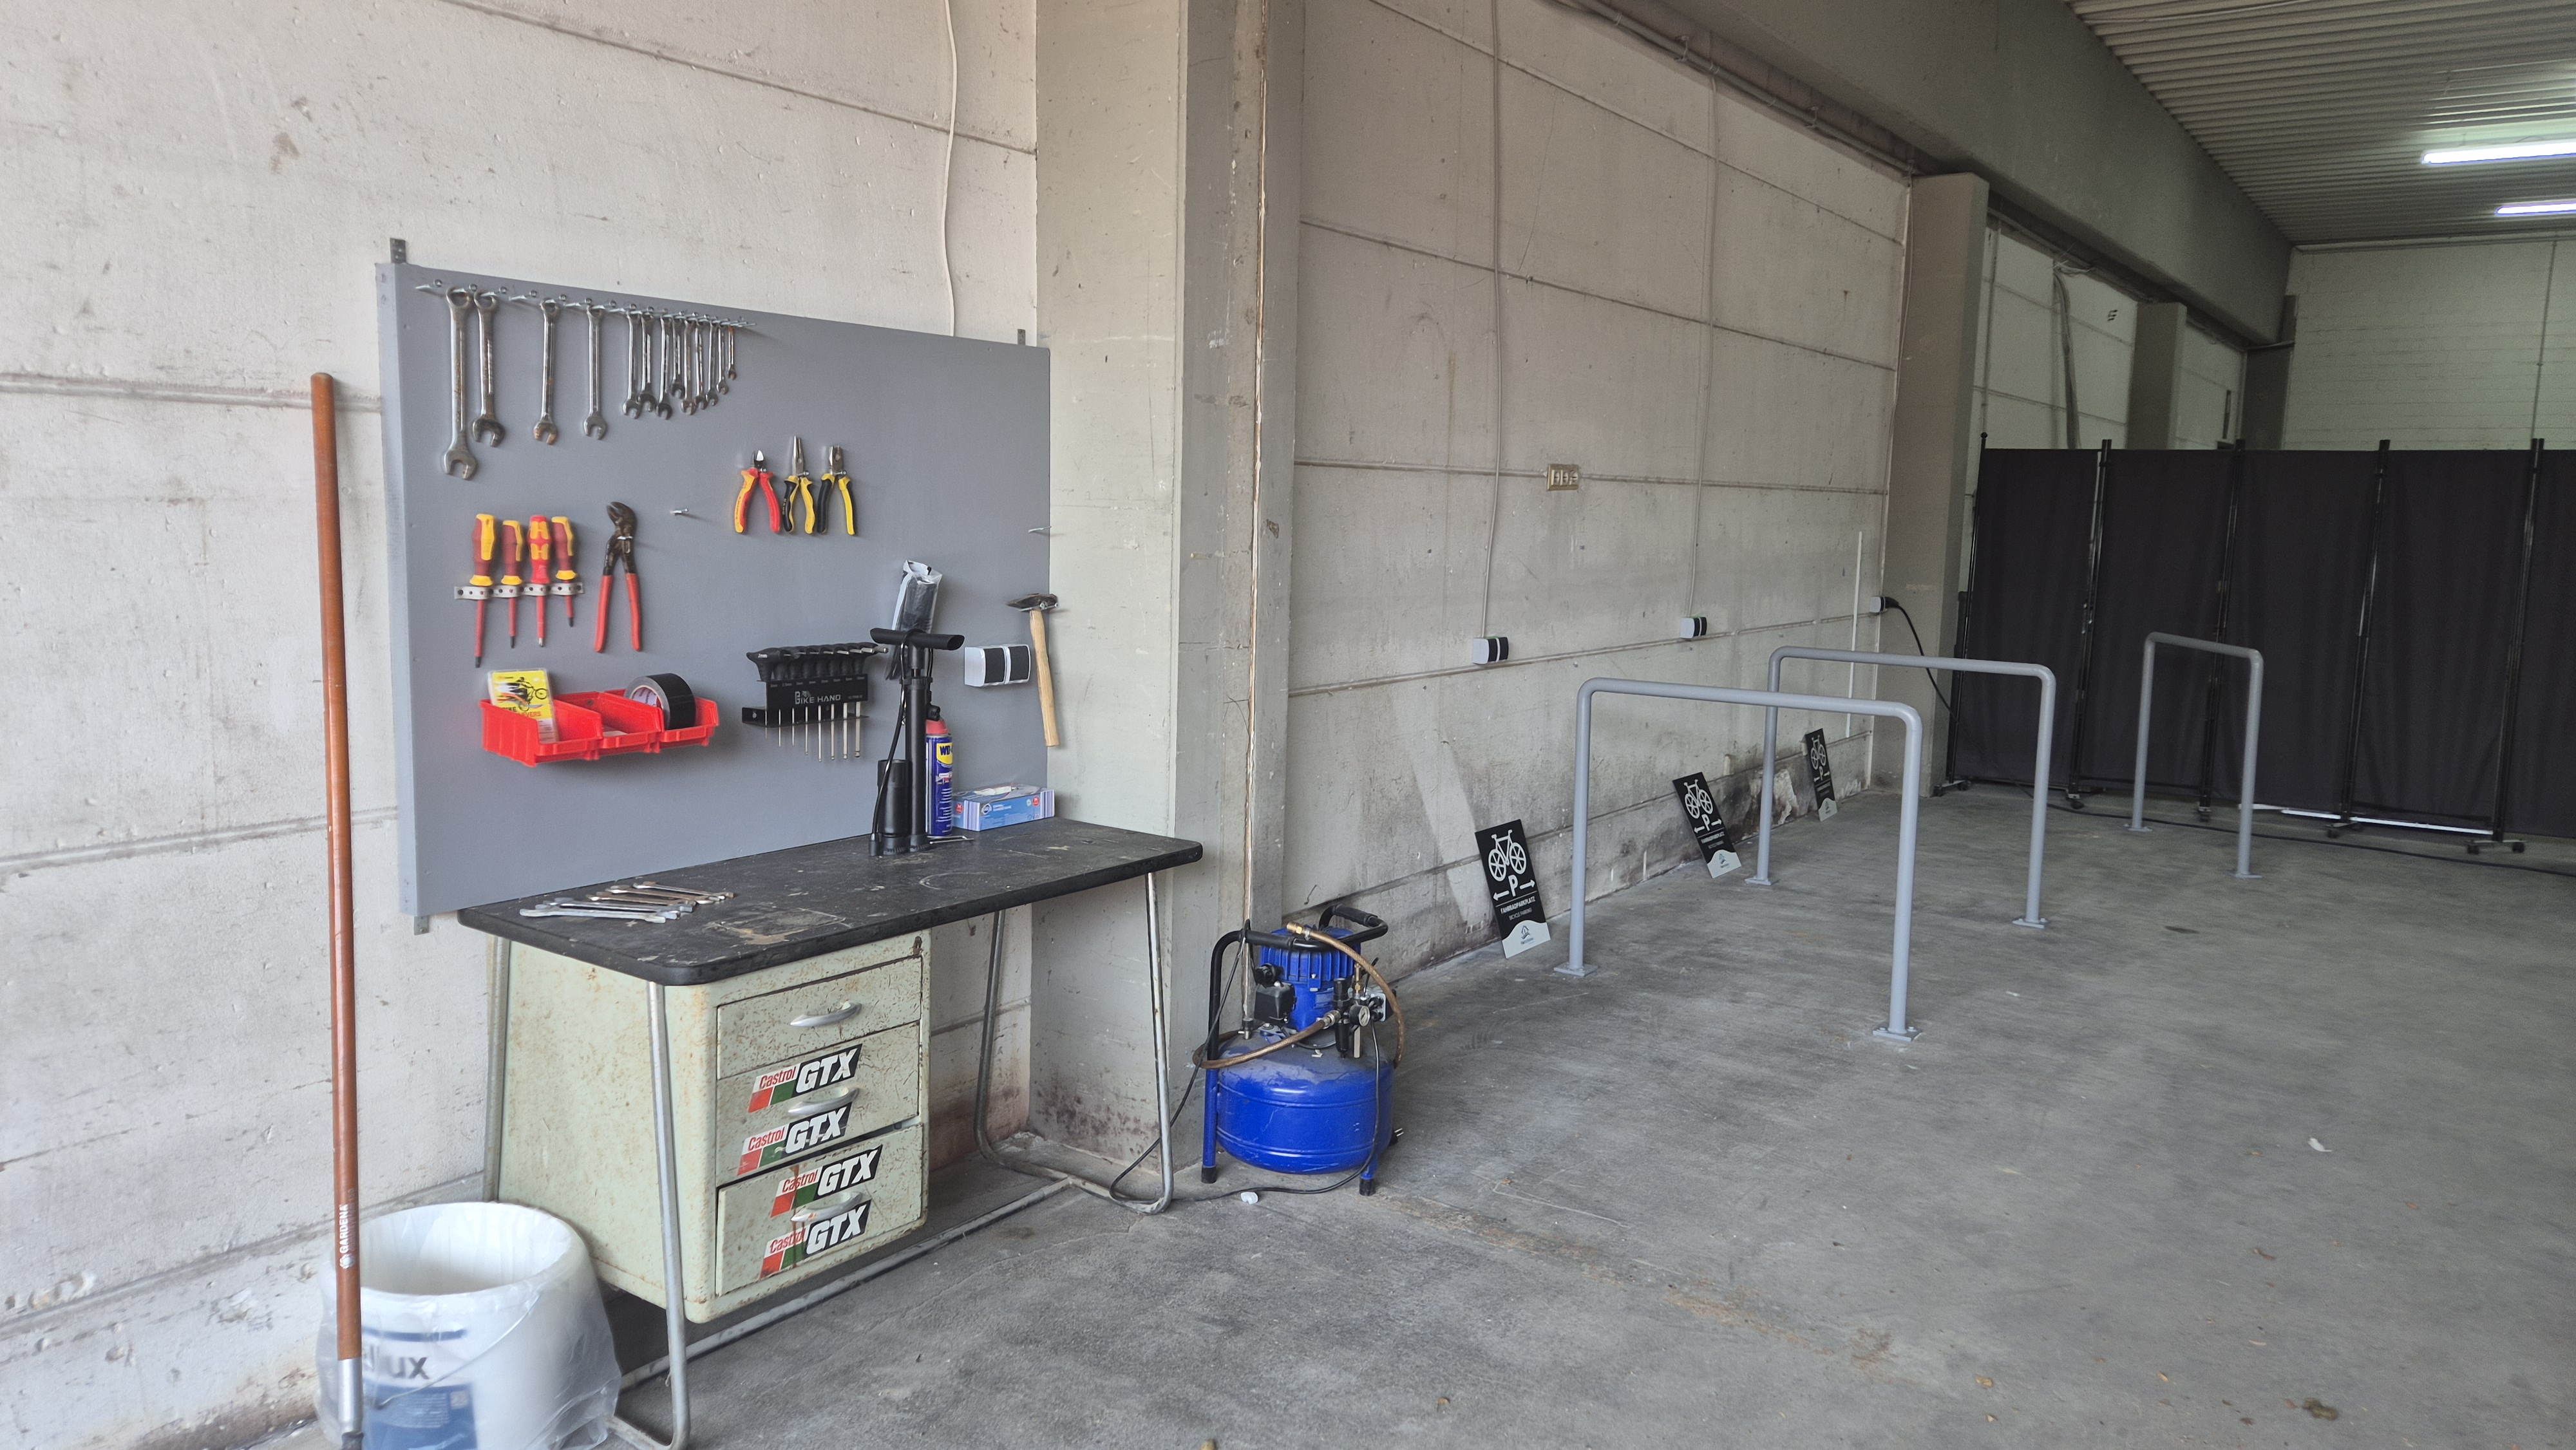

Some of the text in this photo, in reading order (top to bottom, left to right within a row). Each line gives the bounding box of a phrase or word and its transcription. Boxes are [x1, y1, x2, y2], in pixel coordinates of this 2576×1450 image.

[795, 691, 815, 704] BIKE
[817, 694, 841, 703] HAND
[1701, 814, 1710, 831] P
[1500, 896, 1536, 914] FAHRRADPARKPLATZ
[1508, 875, 1519, 896] P
[759, 1047, 858, 1095] Castrol GTX
[748, 1107, 849, 1154] Castrol GTX
[782, 1149, 880, 1197] Castrol GTX
[339, 1203, 349, 1254] GARDENA
[769, 1204, 867, 1256] Castrol GTX
